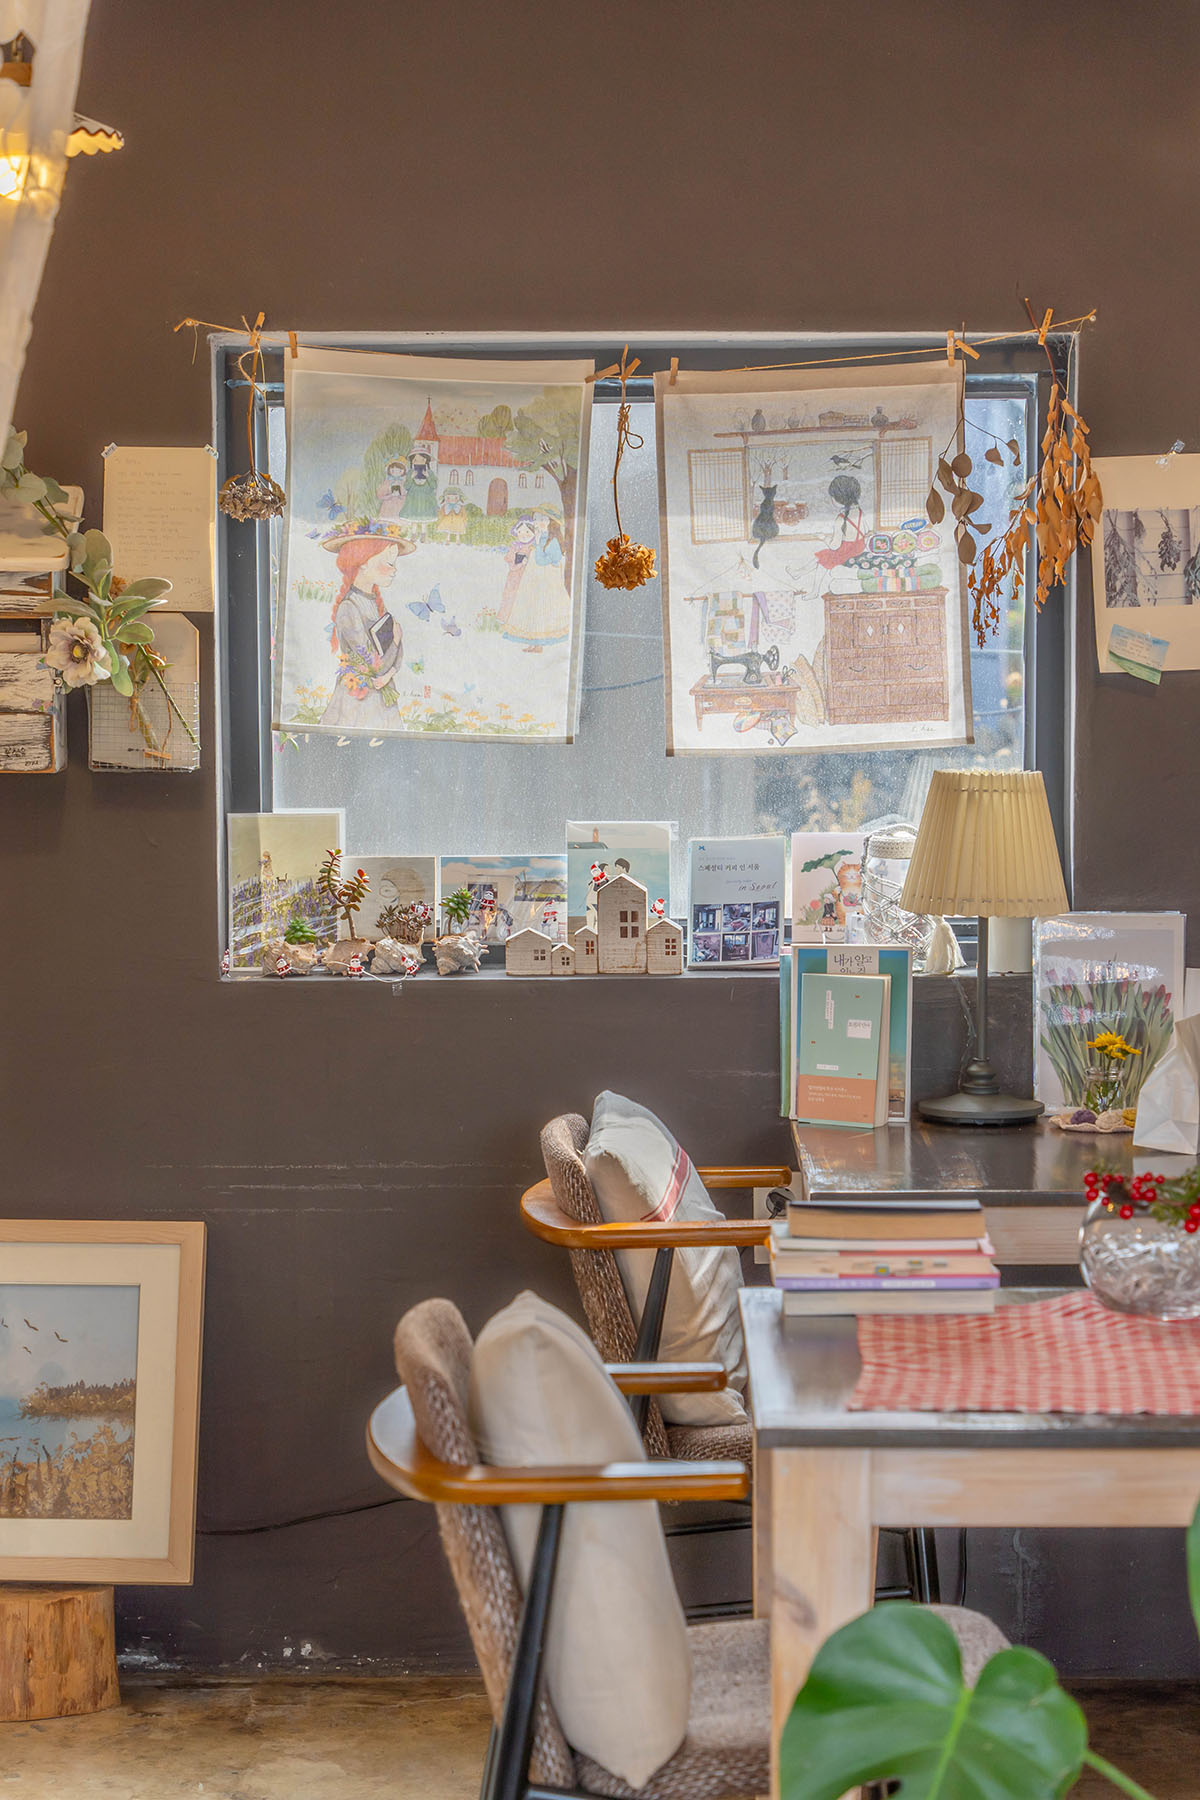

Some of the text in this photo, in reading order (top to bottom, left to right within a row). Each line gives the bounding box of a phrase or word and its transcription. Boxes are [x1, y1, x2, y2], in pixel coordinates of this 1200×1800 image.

[747, 863, 760, 871] 서울
[750, 881, 778, 891] Seoul
[834, 953, 873, 967] 내가 알고
